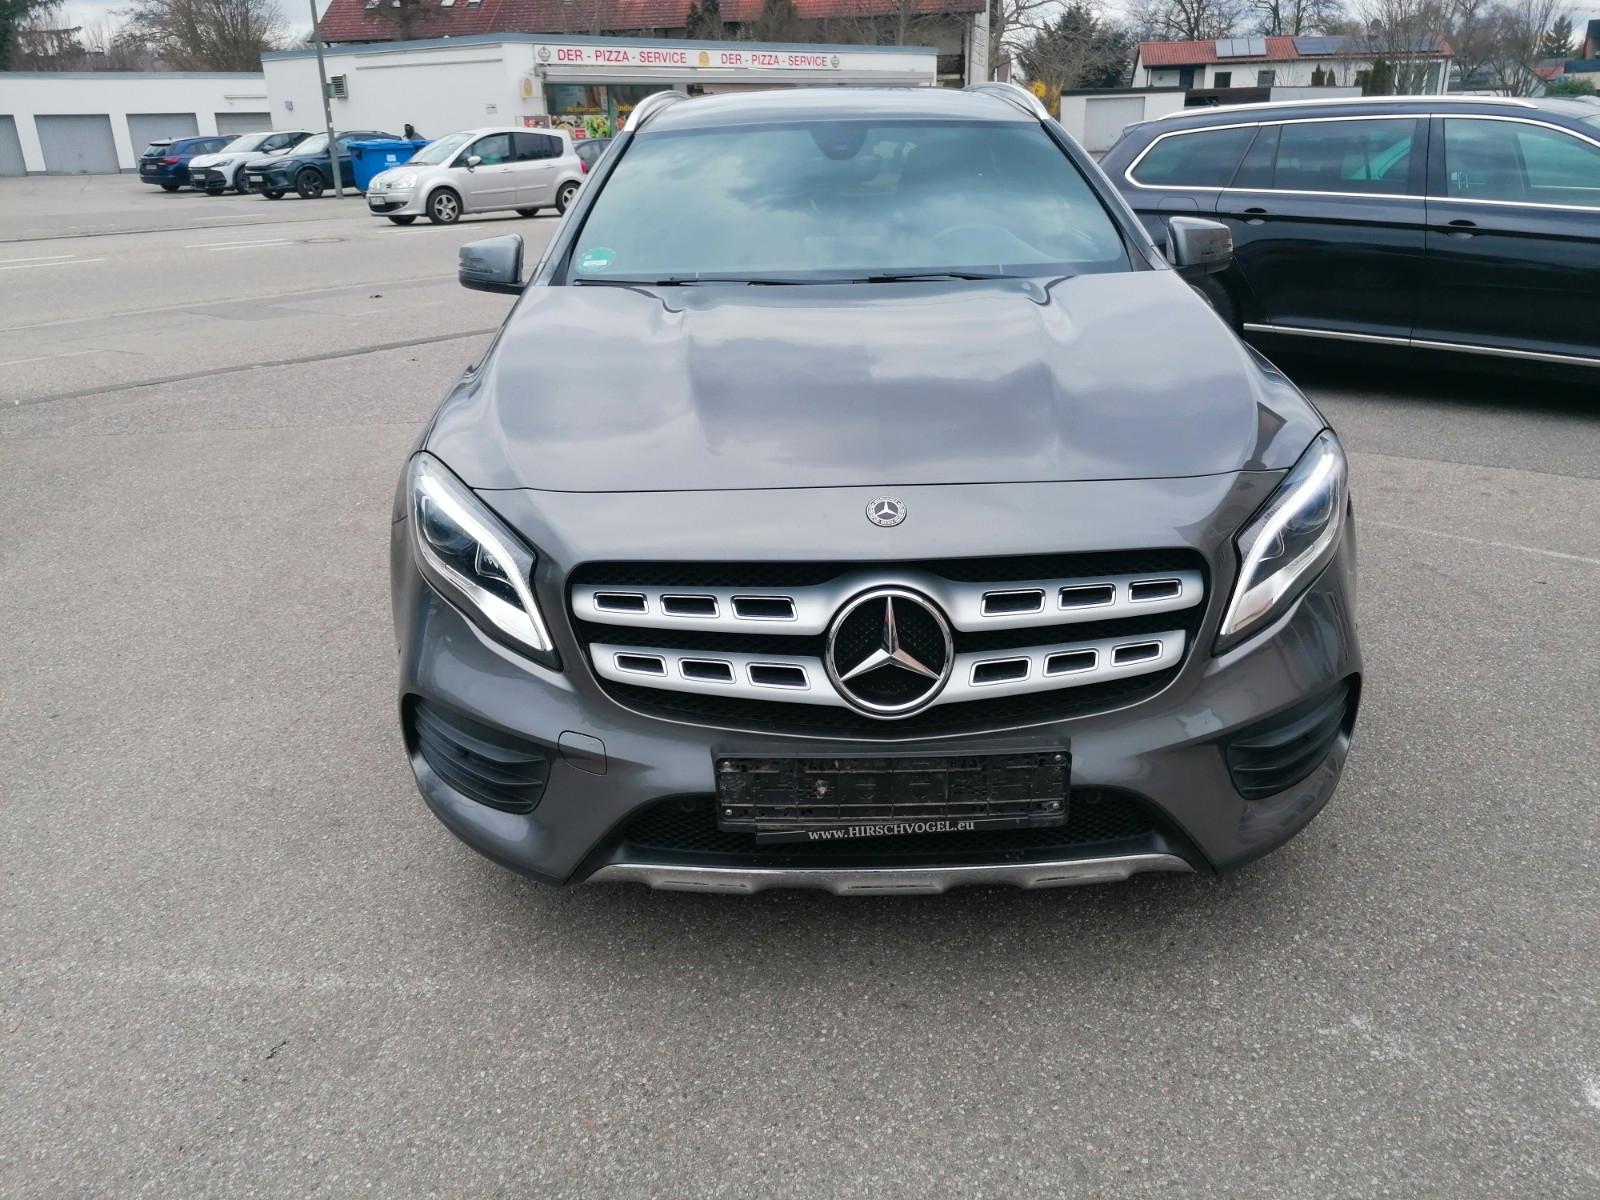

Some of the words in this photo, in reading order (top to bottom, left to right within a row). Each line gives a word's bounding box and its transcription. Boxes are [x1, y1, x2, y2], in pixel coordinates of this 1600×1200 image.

[557, 48, 583, 61] DER
[595, 50, 630, 62] PIZZA
[639, 51, 687, 64] SERVICE
[720, 53, 742, 64] DER
[751, 54, 779, 66] PIZZA
[788, 55, 828, 66] SERVICE
[808, 821, 975, 840] www.HIRSCHVOGEL.eu
